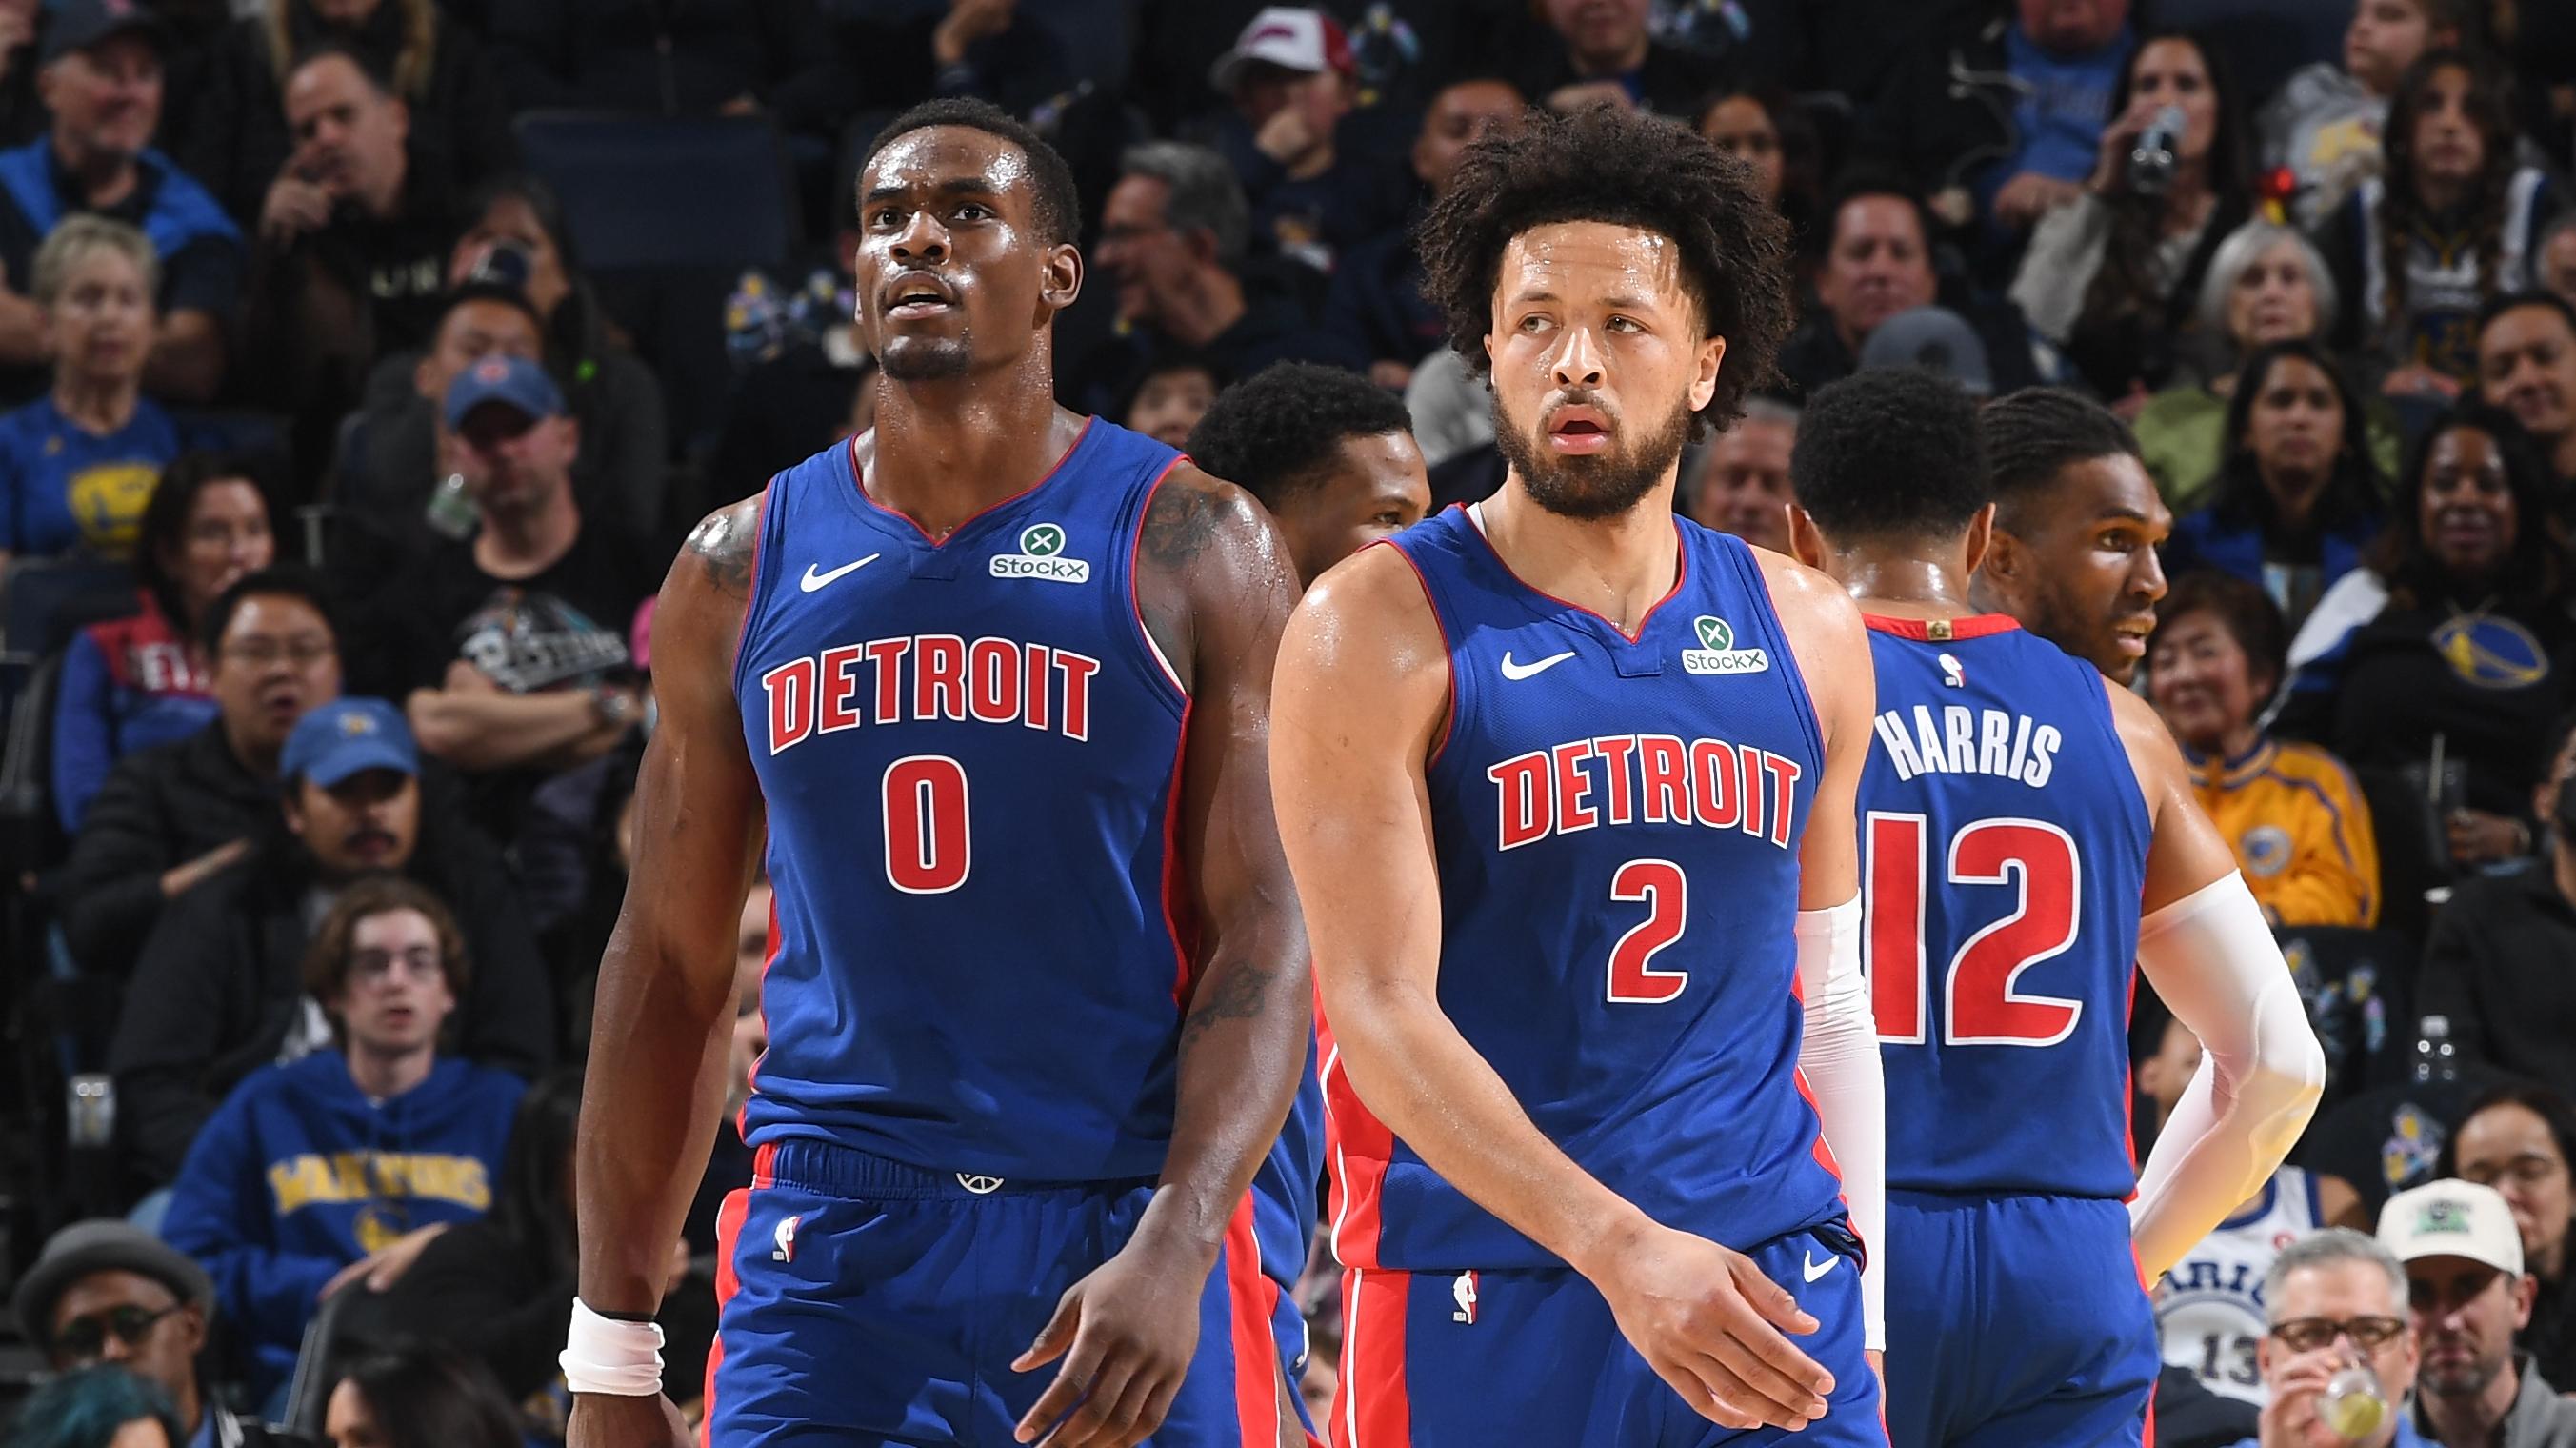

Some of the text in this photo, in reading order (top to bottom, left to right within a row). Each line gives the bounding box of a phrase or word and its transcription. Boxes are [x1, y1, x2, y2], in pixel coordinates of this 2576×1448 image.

[993, 557, 1085, 578] StockX
[762, 634, 1100, 756] DETROIT
[1686, 651, 1765, 670] StockX
[1487, 734, 1801, 851] DETROIT
[1874, 705, 2062, 788] HARRIS
[881, 755, 971, 895] 0
[1606, 858, 1689, 1005] 2
[1865, 811, 2083, 1047] 12
[2200, 1335, 2260, 1386] 13
